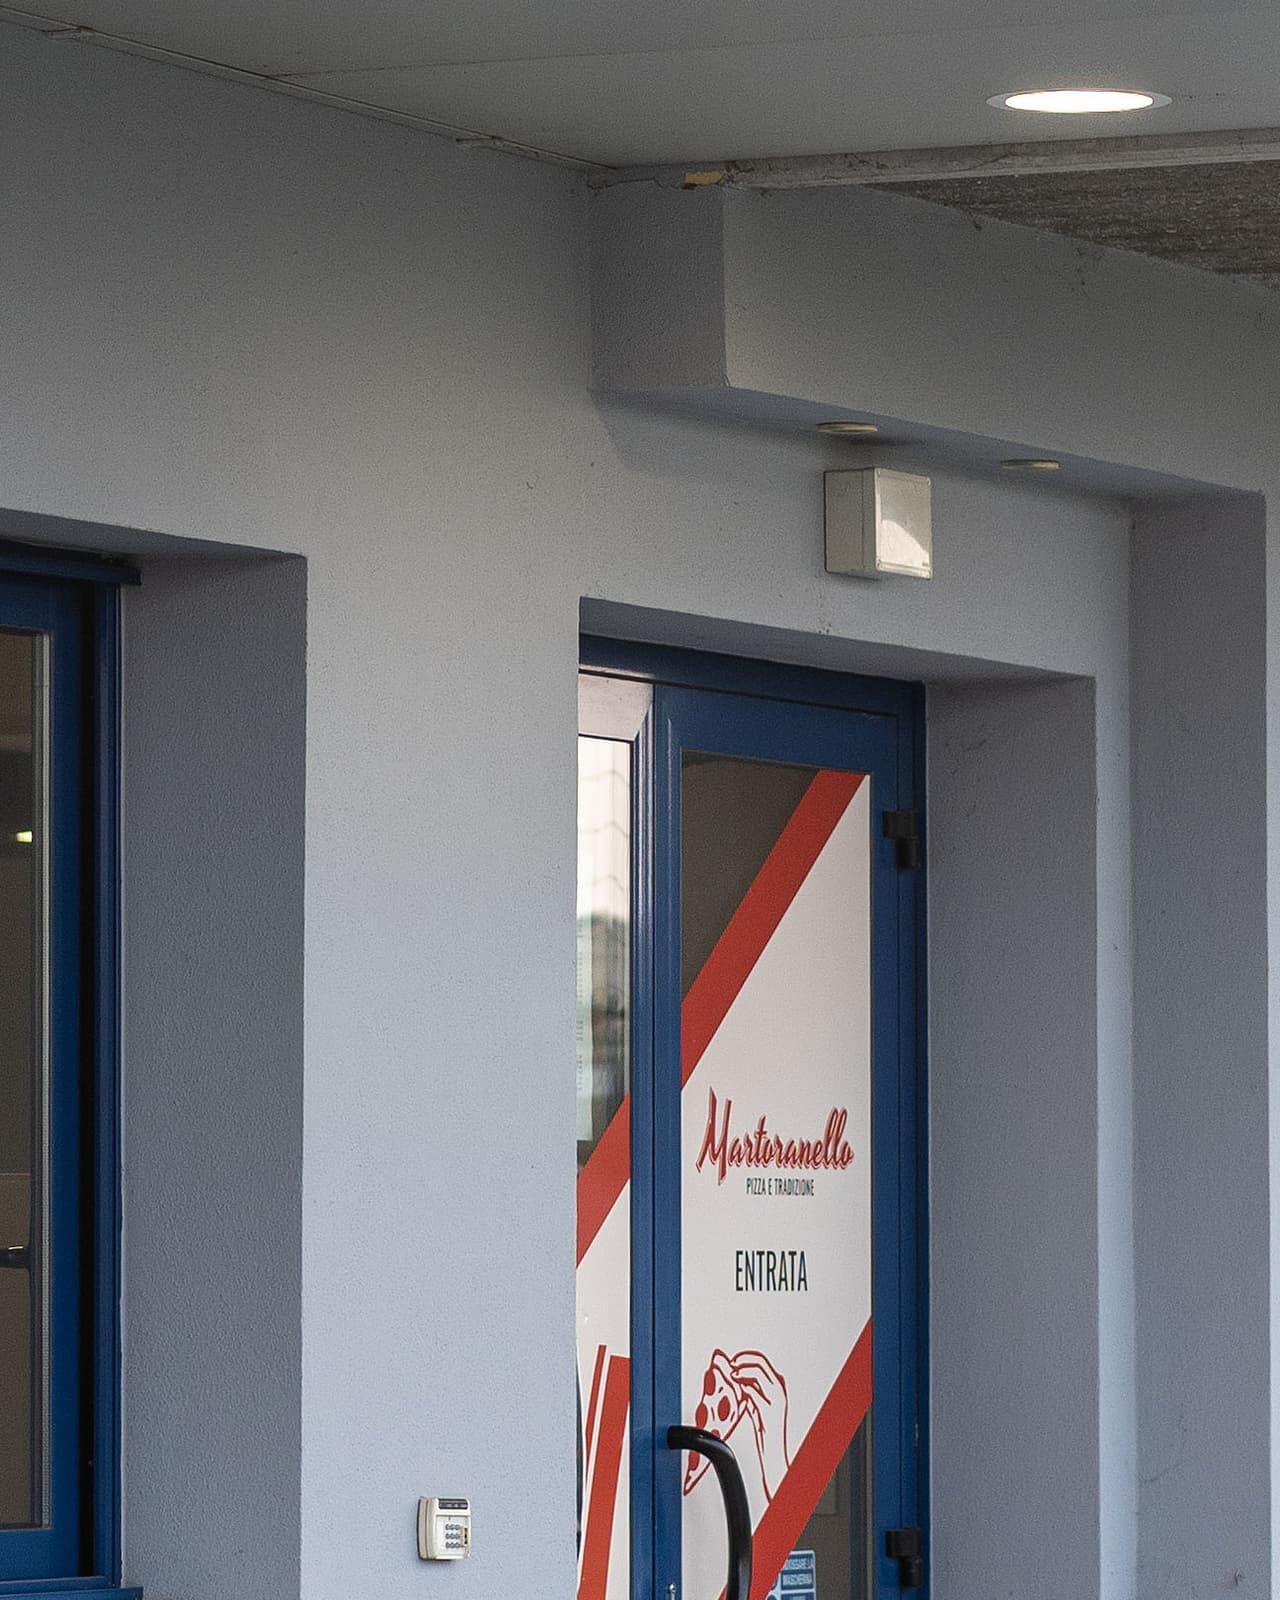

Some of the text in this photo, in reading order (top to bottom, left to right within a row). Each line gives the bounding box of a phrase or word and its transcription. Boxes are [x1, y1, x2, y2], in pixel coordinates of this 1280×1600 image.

[696, 1086, 855, 1186] Martoranello
[746, 1177, 815, 1197] PIZZA E TRADIZIONE
[735, 1250, 808, 1292] ENTRATA
